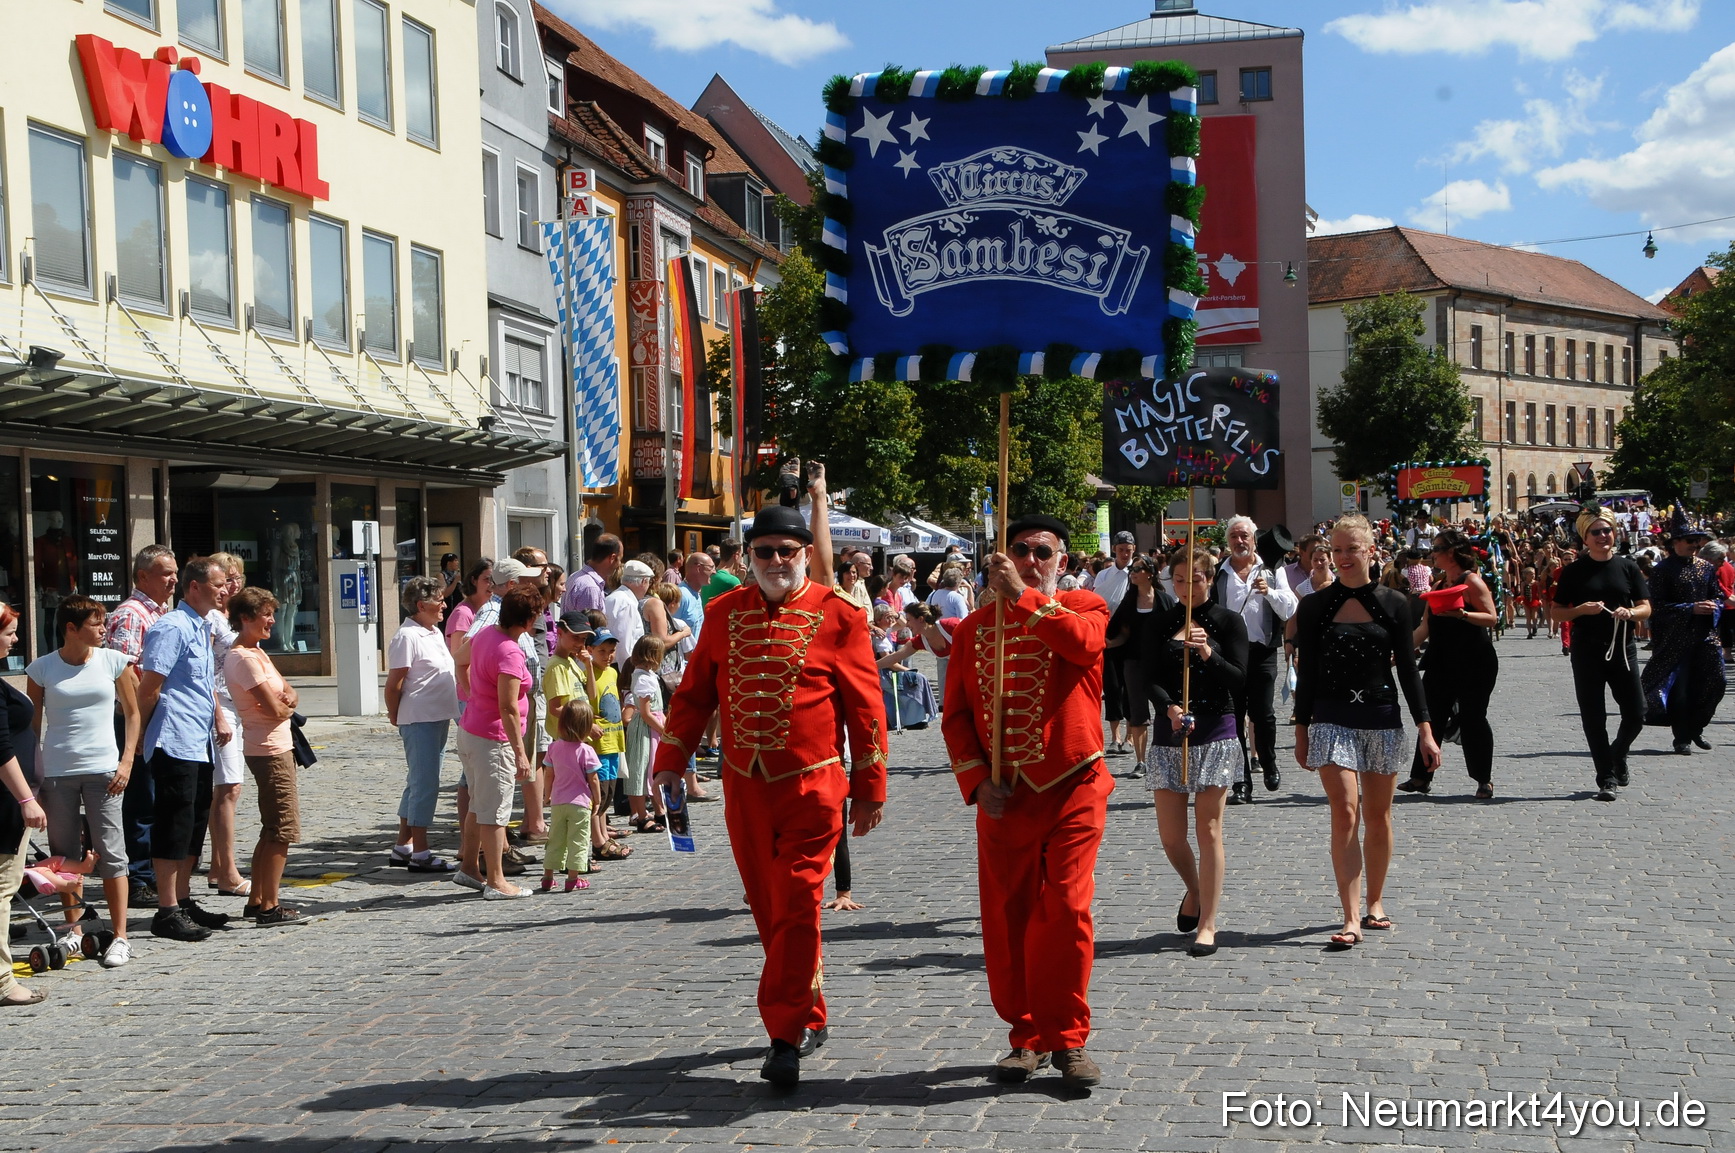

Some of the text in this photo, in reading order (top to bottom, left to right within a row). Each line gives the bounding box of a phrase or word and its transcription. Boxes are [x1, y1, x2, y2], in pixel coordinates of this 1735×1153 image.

[76, 34, 329, 201] WÖHRL
[958, 162, 1056, 199] Circus
[902, 219, 1114, 287] Sambesi
[1115, 372, 1207, 432] MAGIC
[1417, 481, 1463, 493] Sambesi
[88, 552, 102, 560] Marc
[92, 572, 113, 581] BRAX
